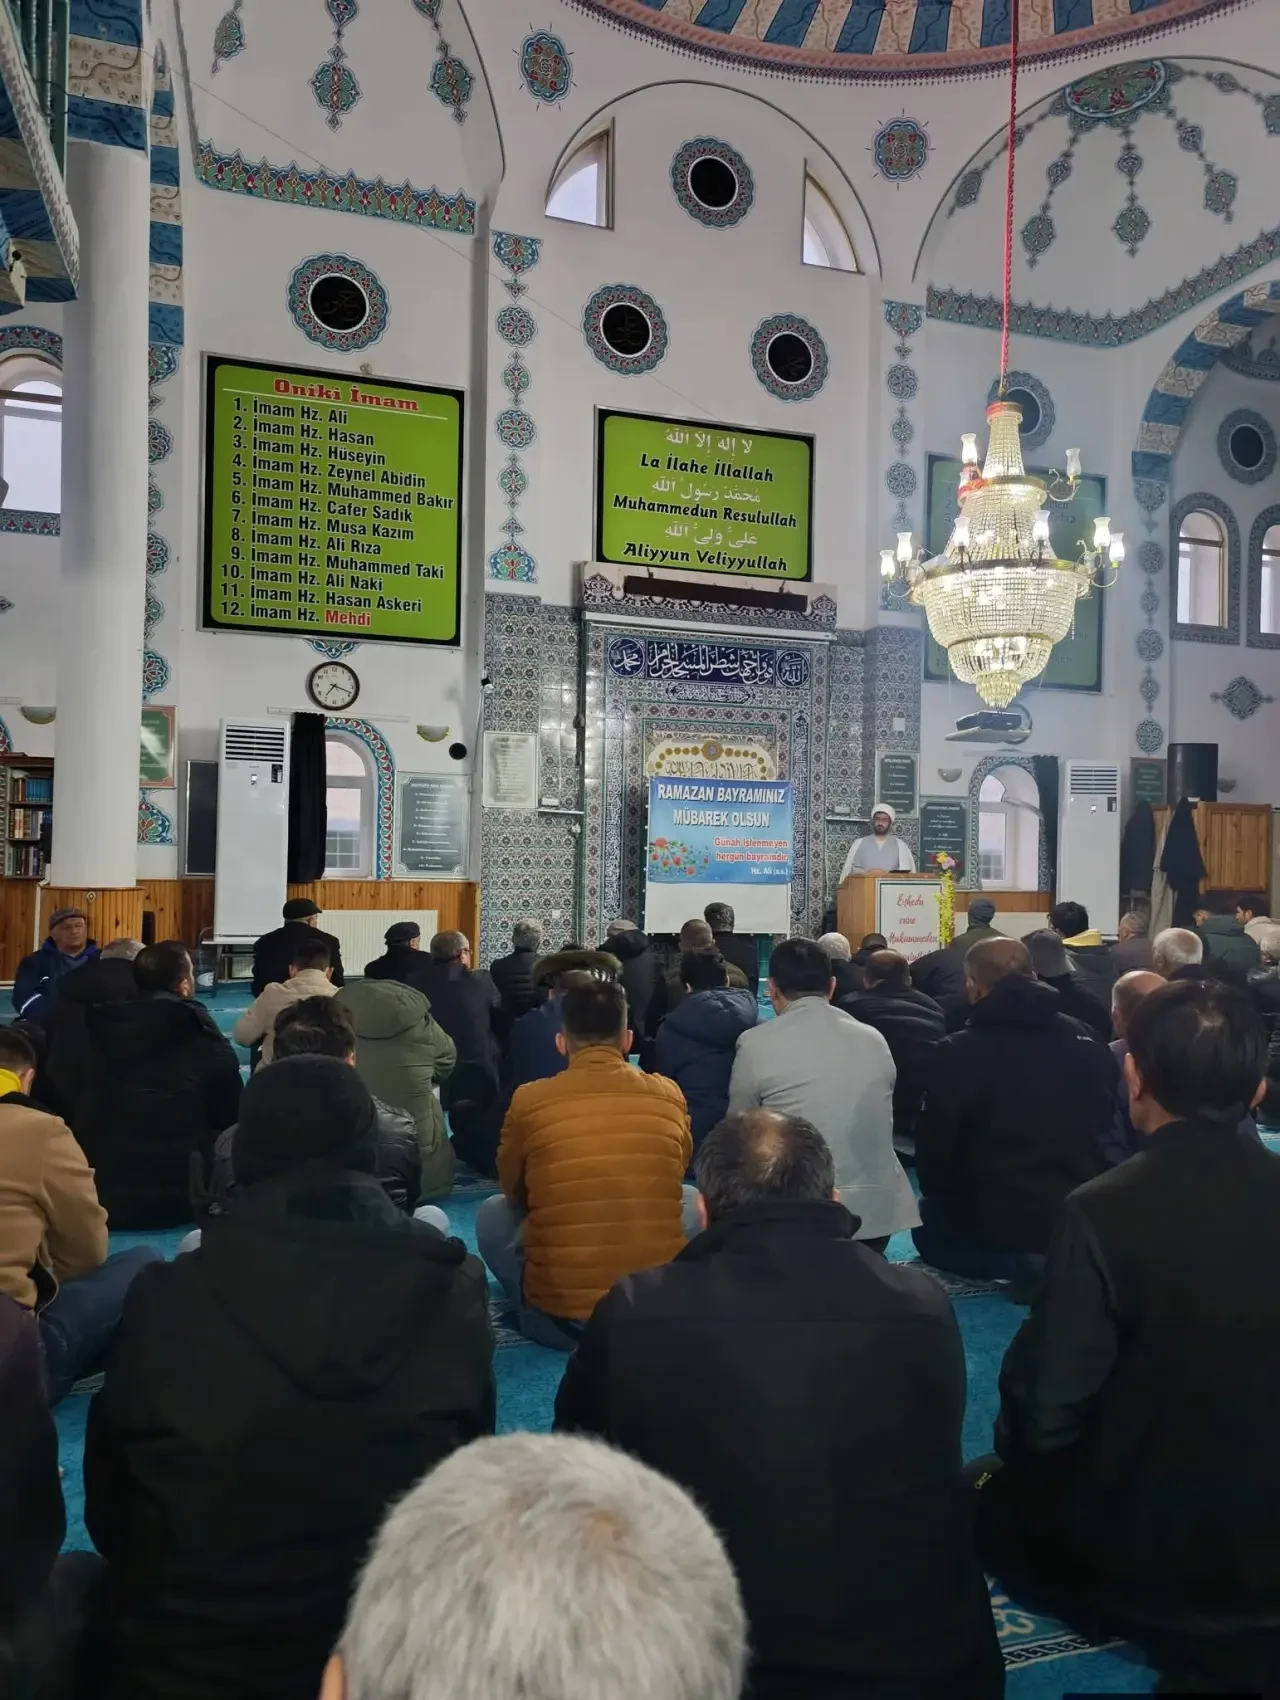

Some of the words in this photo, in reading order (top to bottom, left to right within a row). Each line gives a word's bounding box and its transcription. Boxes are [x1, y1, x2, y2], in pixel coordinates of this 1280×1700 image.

[274, 378, 341, 400] Oniki
[350, 385, 419, 411] İmam
[234, 397, 247, 412] 1.
[253, 396, 294, 418] İmam
[301, 406, 322, 421] Hz.
[328, 410, 348, 424] Ali
[233, 416, 247, 430] 2.
[253, 415, 294, 436] İmam
[301, 424, 322, 440] Hz.
[328, 428, 374, 446] Hasan
[233, 434, 247, 449] 3.
[253, 433, 294, 454] İmam
[300, 442, 322, 458] Hz.
[328, 446, 385, 466] Hüseyin
[641, 454, 660, 468] La
[232, 454, 246, 467] 4.
[253, 452, 294, 473] İmam
[300, 461, 322, 476] Hz.
[328, 464, 375, 482] Zeynel
[381, 470, 426, 488] Abidin
[232, 472, 246, 486] 5.
[252, 470, 294, 491] İmam
[300, 479, 322, 494] Hz.
[328, 482, 411, 504] Muhammed
[418, 492, 454, 508] Bakır
[232, 490, 246, 504] 6.
[252, 488, 293, 510] İmam
[300, 498, 321, 512] Hz.
[327, 500, 368, 517] Cafer
[372, 505, 412, 522] Sadık
[613, 494, 718, 518] Muhammedun
[724, 507, 797, 528] Resulullah
[232, 508, 246, 523] 7.
[252, 508, 293, 528] İmam
[299, 516, 320, 530] Hz.
[327, 519, 366, 536] Musa
[372, 523, 414, 540] Kazım
[232, 528, 244, 542] 8.
[252, 526, 292, 546] İmam
[299, 534, 320, 549] Hz.
[326, 537, 344, 551] Ali
[351, 540, 380, 554] Rıza
[232, 546, 244, 560] 9.
[252, 544, 292, 564] İmam
[298, 553, 320, 568] Hz.
[326, 555, 410, 576] Muhammed
[416, 564, 444, 578] Taki
[624, 543, 690, 563] Aliyyun
[697, 550, 787, 572] Veliyyullah
[222, 564, 244, 578] 10.
[252, 563, 292, 583] İmam
[298, 571, 320, 585] Hz.
[326, 574, 344, 588] Ali
[350, 576, 382, 590] Naki
[222, 583, 244, 598] 11.
[251, 582, 292, 601] İmam
[298, 590, 320, 604] Hz.
[326, 592, 371, 608] Hasan
[377, 596, 421, 612] Askeri
[222, 602, 244, 616] 12.
[251, 600, 291, 620] İmam
[298, 608, 319, 622] Hz.
[326, 610, 370, 626] Mehdi
[658, 784, 714, 800] RAMAZAN
[717, 785, 785, 804] BAYRAMINIZ
[673, 806, 728, 827] MÜBAREK
[732, 812, 770, 828] OLSUN
